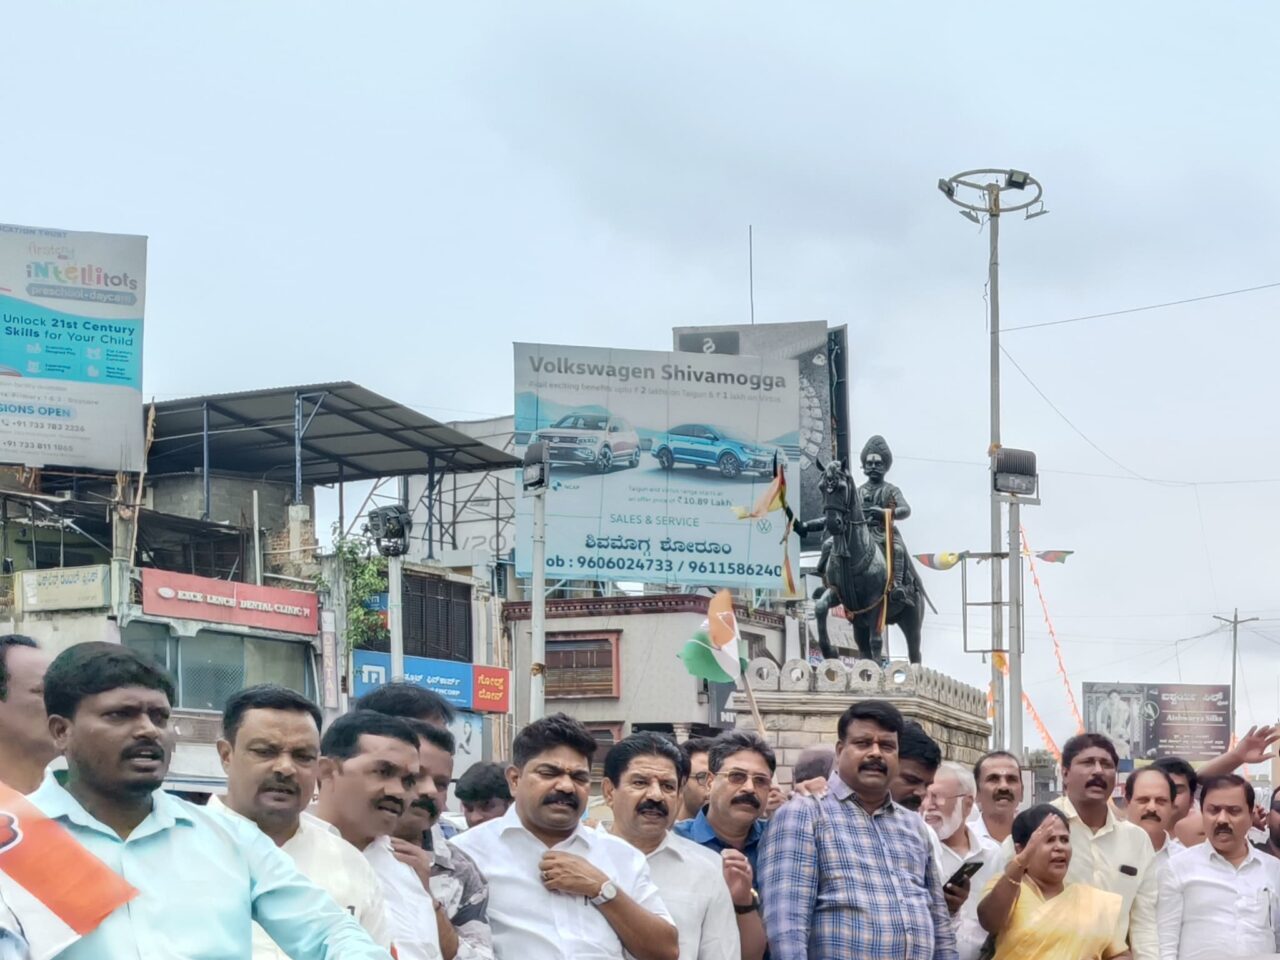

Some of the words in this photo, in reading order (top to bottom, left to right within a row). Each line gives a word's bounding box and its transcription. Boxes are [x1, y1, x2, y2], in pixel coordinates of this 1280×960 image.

[3, 313, 46, 327] Unlock
[51, 318, 78, 329] 21st
[82, 321, 135, 336] Century
[5, 326, 40, 338] Skills
[44, 330, 61, 340] for
[67, 332, 95, 343] Your
[101, 334, 134, 346] Child
[529, 355, 655, 382] Volkswagen
[661, 363, 787, 391] Shivamogga
[38, 406, 71, 417] OPEN
[610, 513, 642, 525] SALES
[645, 515, 652, 525] &
[656, 515, 700, 527] SERVICE
[546, 555, 565, 568] ob
[577, 556, 673, 573] 9606024733
[688, 561, 782, 578] 9611586240
[240, 599, 273, 612] DENTAL
[274, 603, 303, 616] CLINIC
[1166, 713, 1204, 723] Aishwarya
[1206, 714, 1224, 722] Silks
